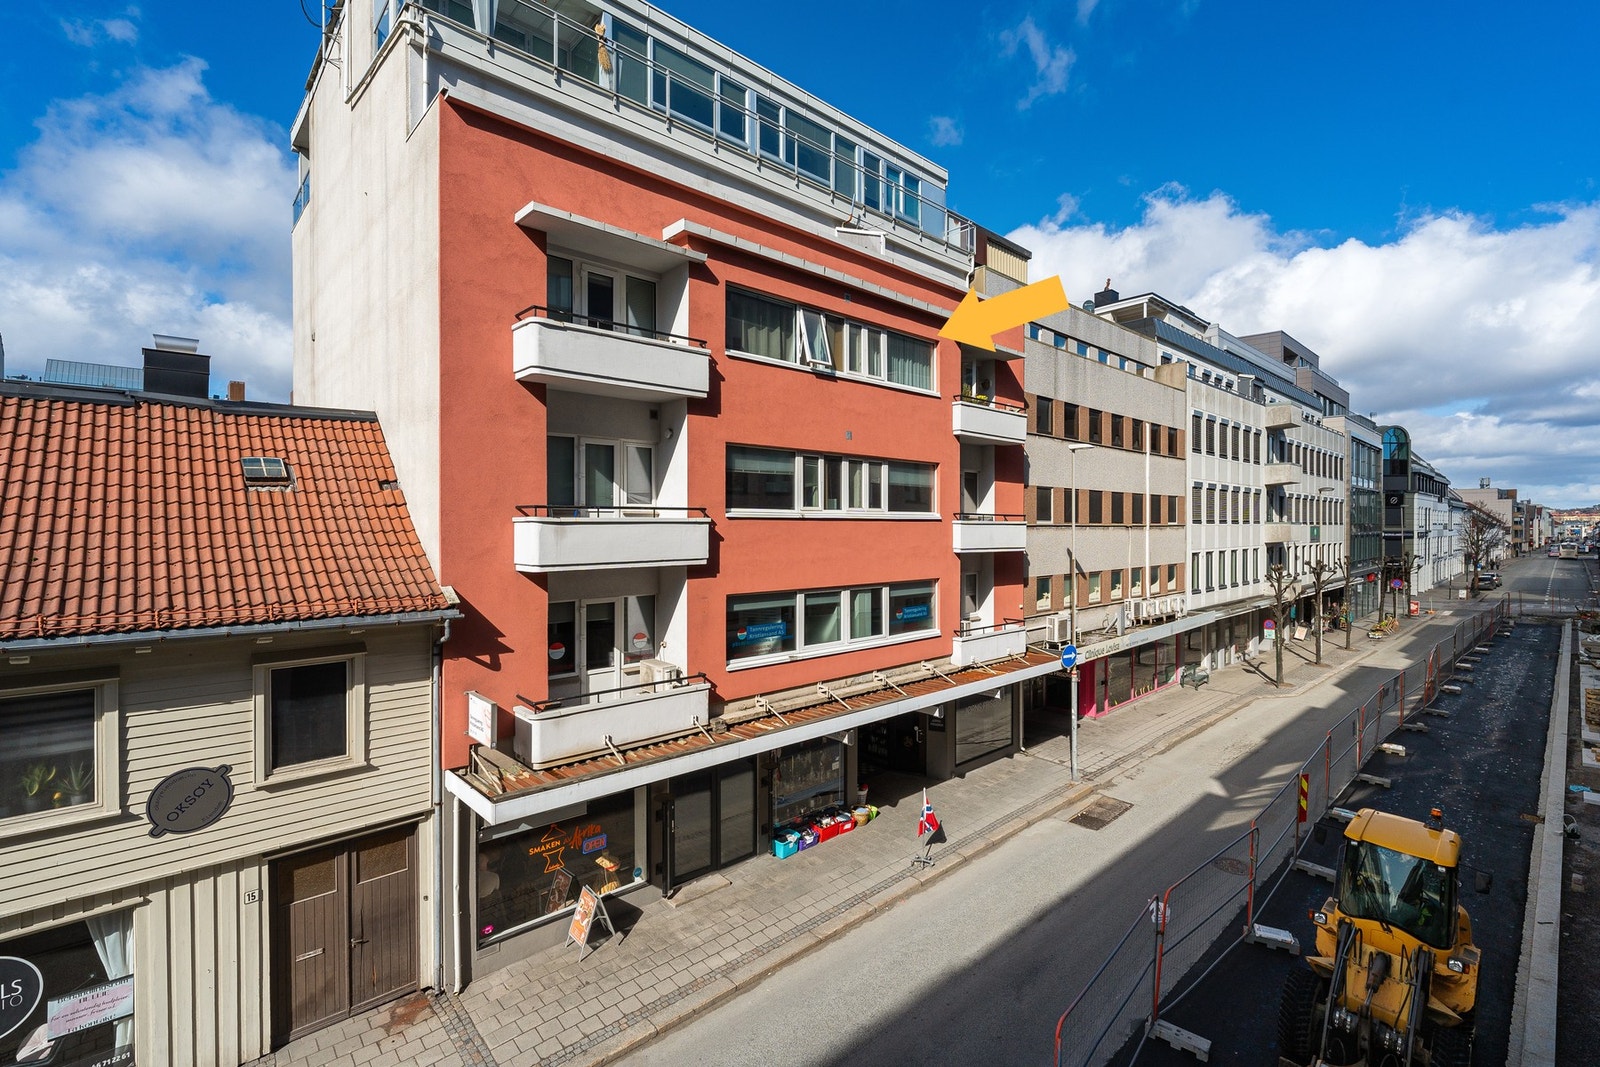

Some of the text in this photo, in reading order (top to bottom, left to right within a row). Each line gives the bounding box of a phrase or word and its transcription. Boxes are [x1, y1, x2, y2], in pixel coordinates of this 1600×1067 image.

[166, 778, 214, 821] OKSØY
[529, 840, 560, 856] SMAKEN
[584, 838, 605, 851] OPEN
[246, 891, 257, 902] 15
[102, 1059, 111, 1067] 71
[112, 1055, 121, 1064] 22
[121, 1051, 131, 1060] 61
